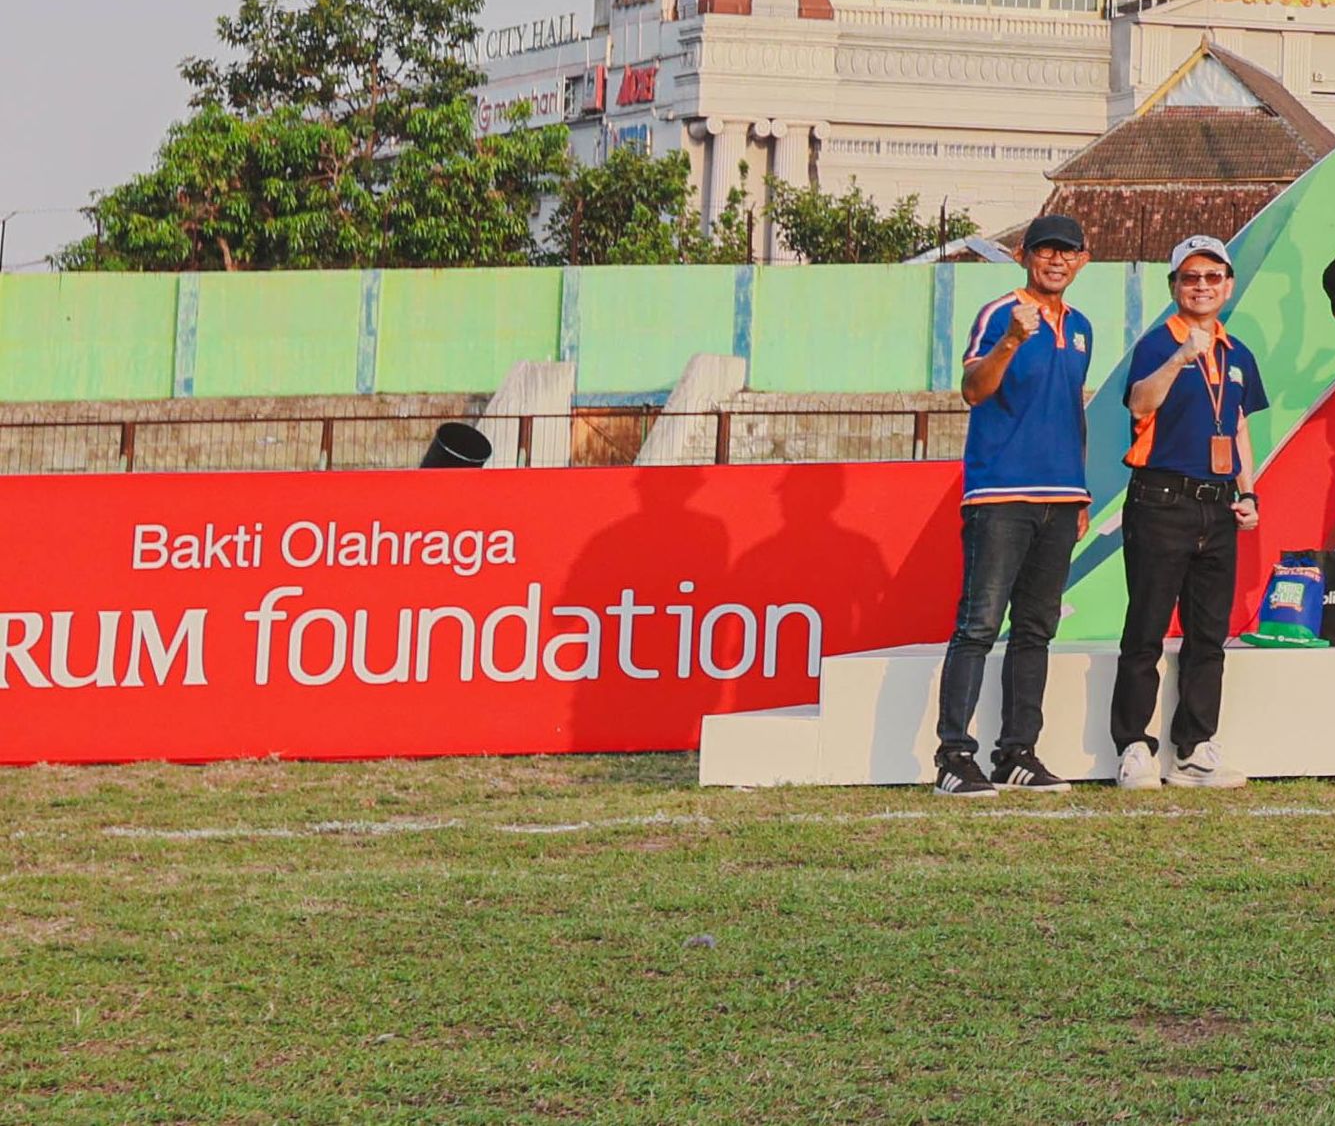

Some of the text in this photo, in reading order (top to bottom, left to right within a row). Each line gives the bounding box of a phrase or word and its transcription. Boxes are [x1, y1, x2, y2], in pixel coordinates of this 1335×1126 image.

[487, 24, 528, 60] CITY
[532, 12, 581, 53] HALL
[494, 81, 560, 123] mhari
[132, 520, 517, 577] Bakti Olahraga
[244, 580, 824, 686] foundation
